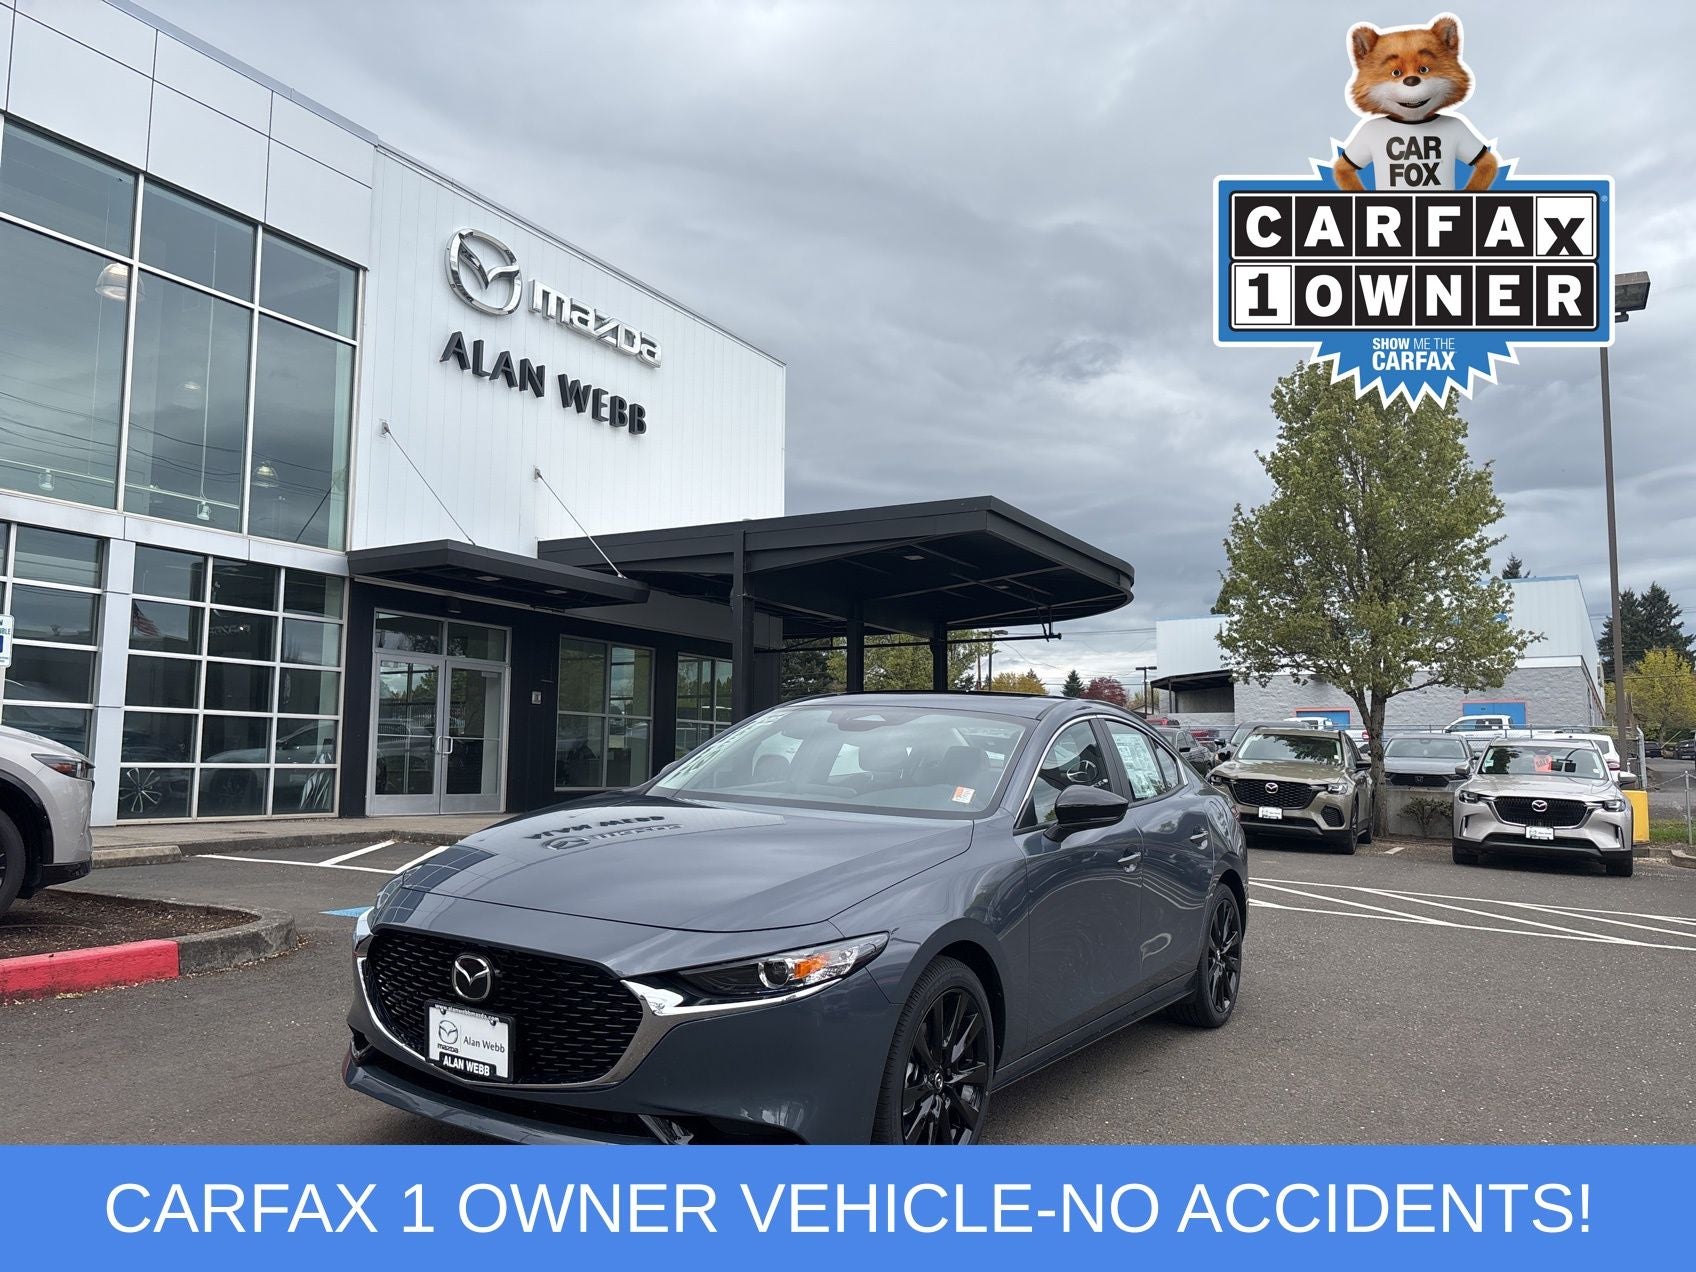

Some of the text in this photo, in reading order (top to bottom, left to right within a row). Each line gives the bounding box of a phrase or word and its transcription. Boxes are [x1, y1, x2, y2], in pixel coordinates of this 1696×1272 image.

[439, 331, 647, 435] ALAN WEBB
[463, 1036, 505, 1053] Alan Webb
[443, 1055, 490, 1076] ALAN WEBB
